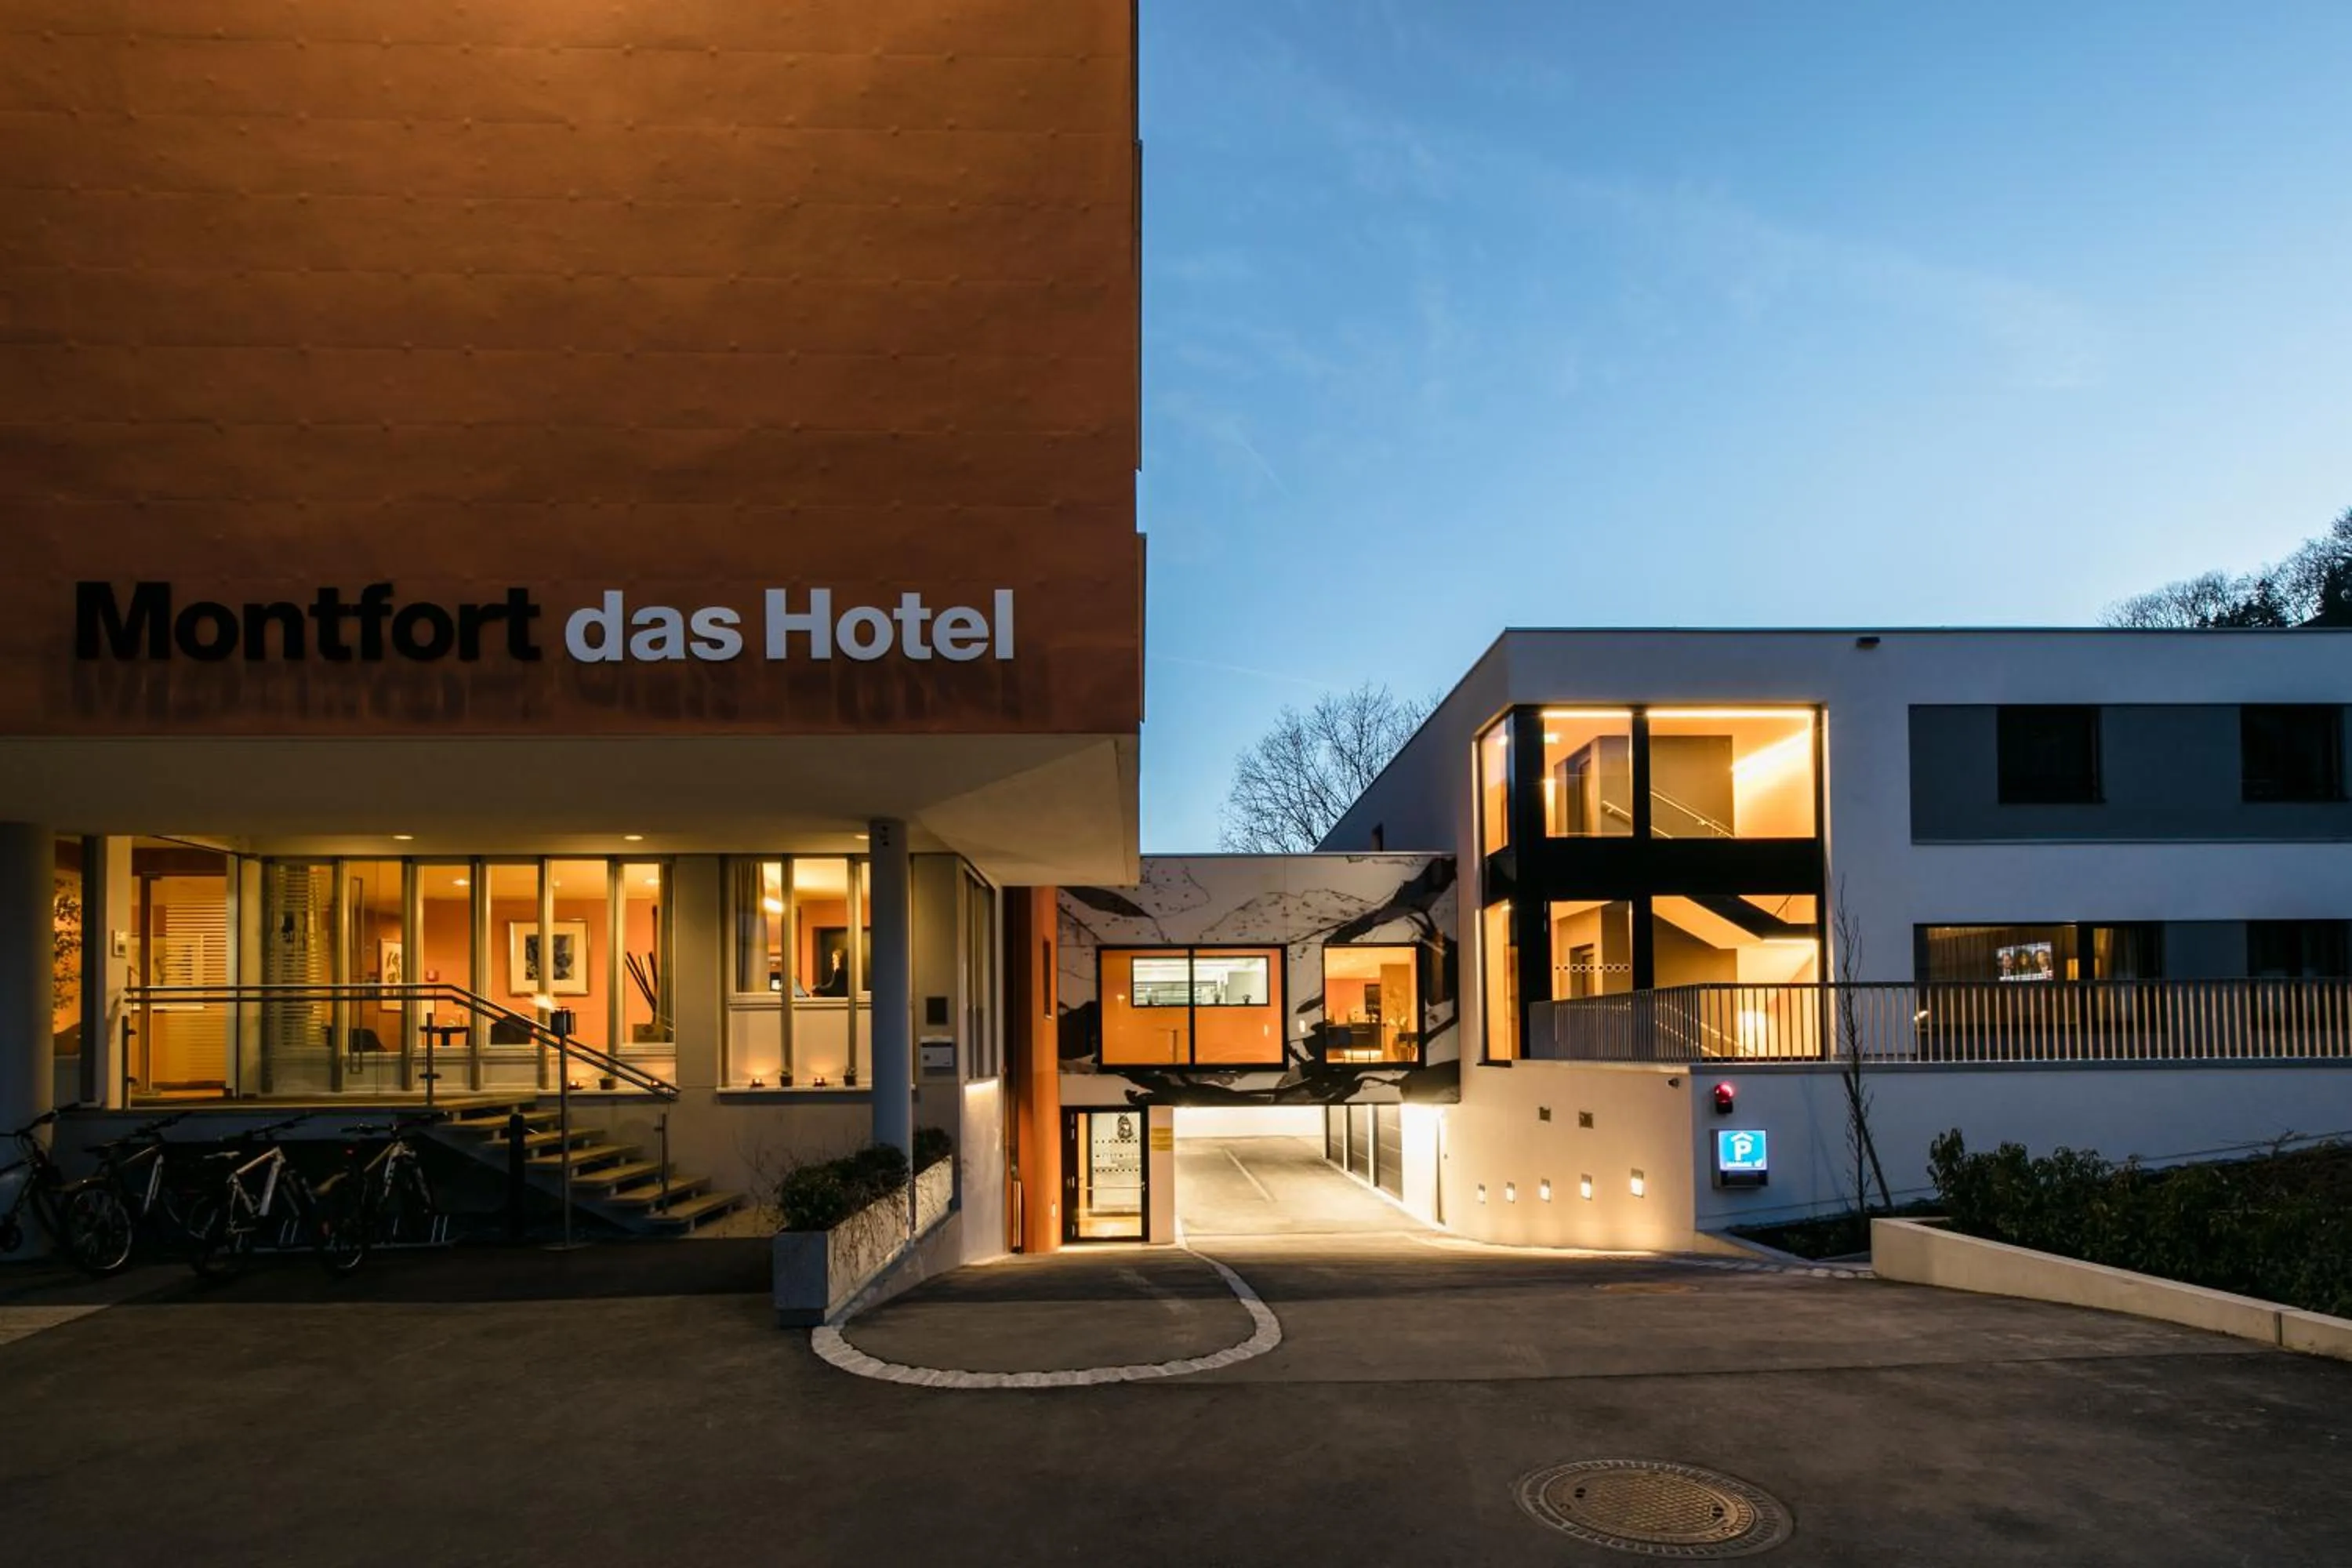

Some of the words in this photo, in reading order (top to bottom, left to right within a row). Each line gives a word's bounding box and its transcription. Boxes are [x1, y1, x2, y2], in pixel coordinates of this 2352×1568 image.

[75, 582, 541, 662] Montfort
[564, 590, 743, 662] das
[765, 588, 1014, 661] Hotel
[1734, 1141, 1752, 1161] P
